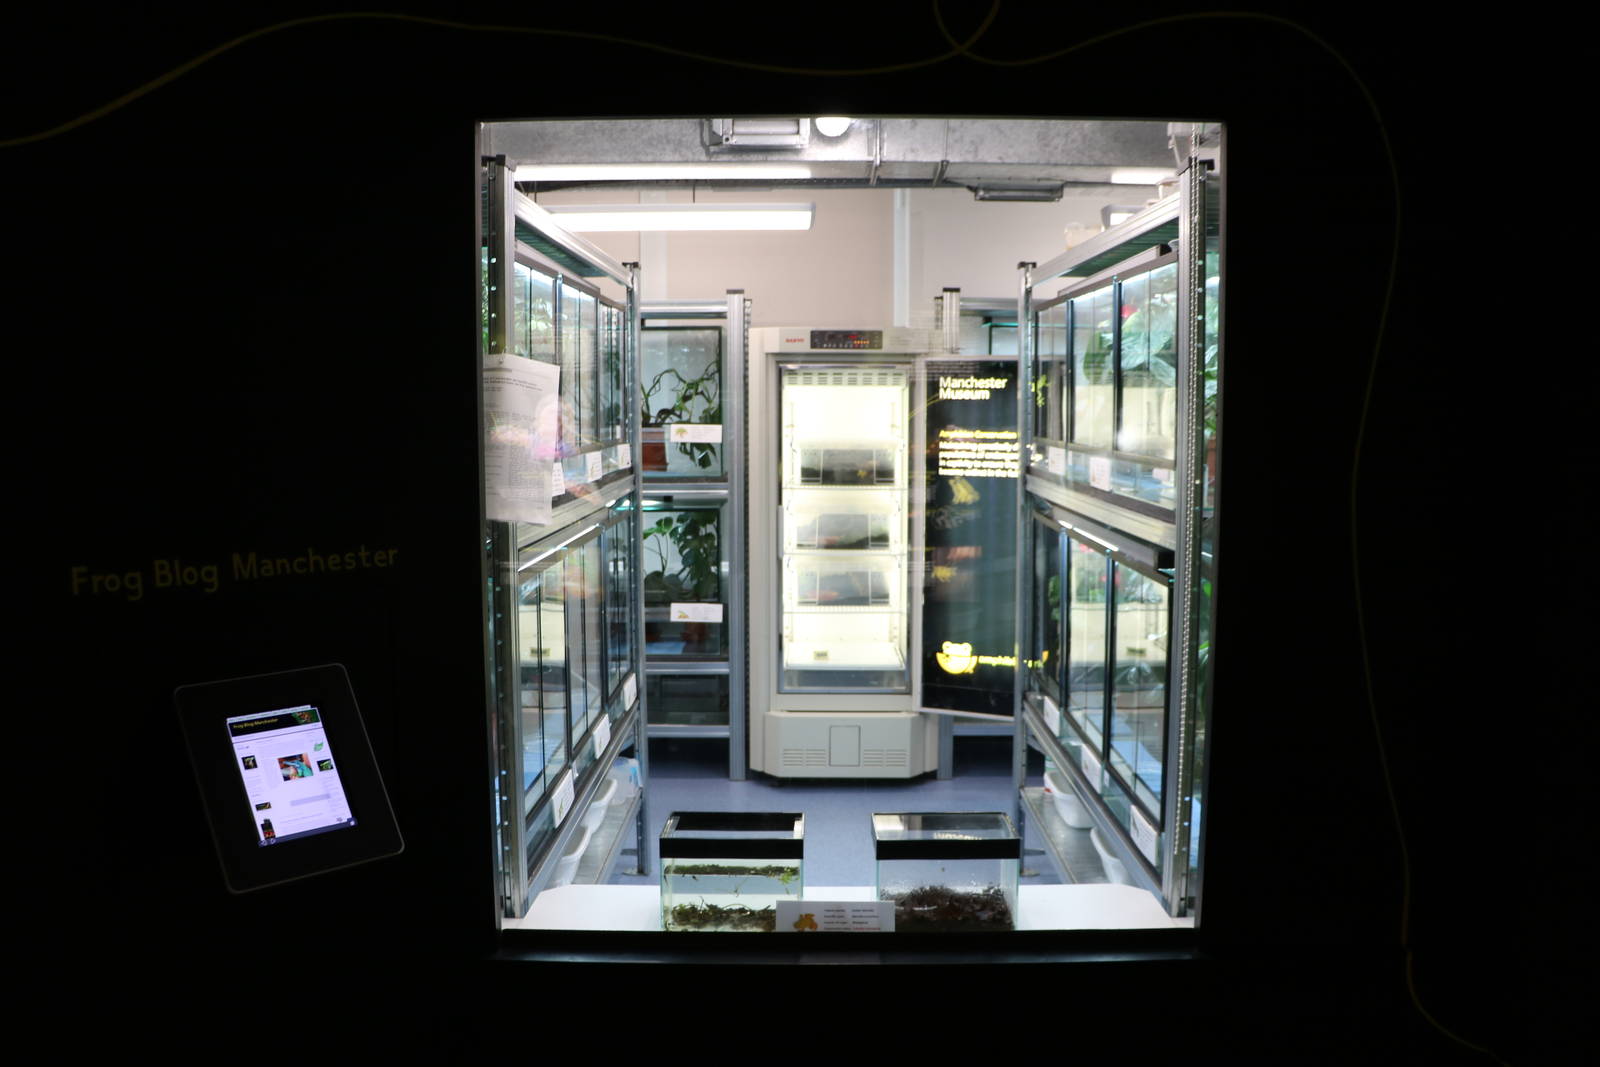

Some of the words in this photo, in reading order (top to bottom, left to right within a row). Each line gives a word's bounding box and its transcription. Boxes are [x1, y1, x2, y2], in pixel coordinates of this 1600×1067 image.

[939, 376, 1008, 389] Manchester
[939, 388, 990, 400] Museum
[71, 565, 145, 602] Frog
[152, 558, 219, 593] Blog
[231, 545, 399, 582] Manchester
